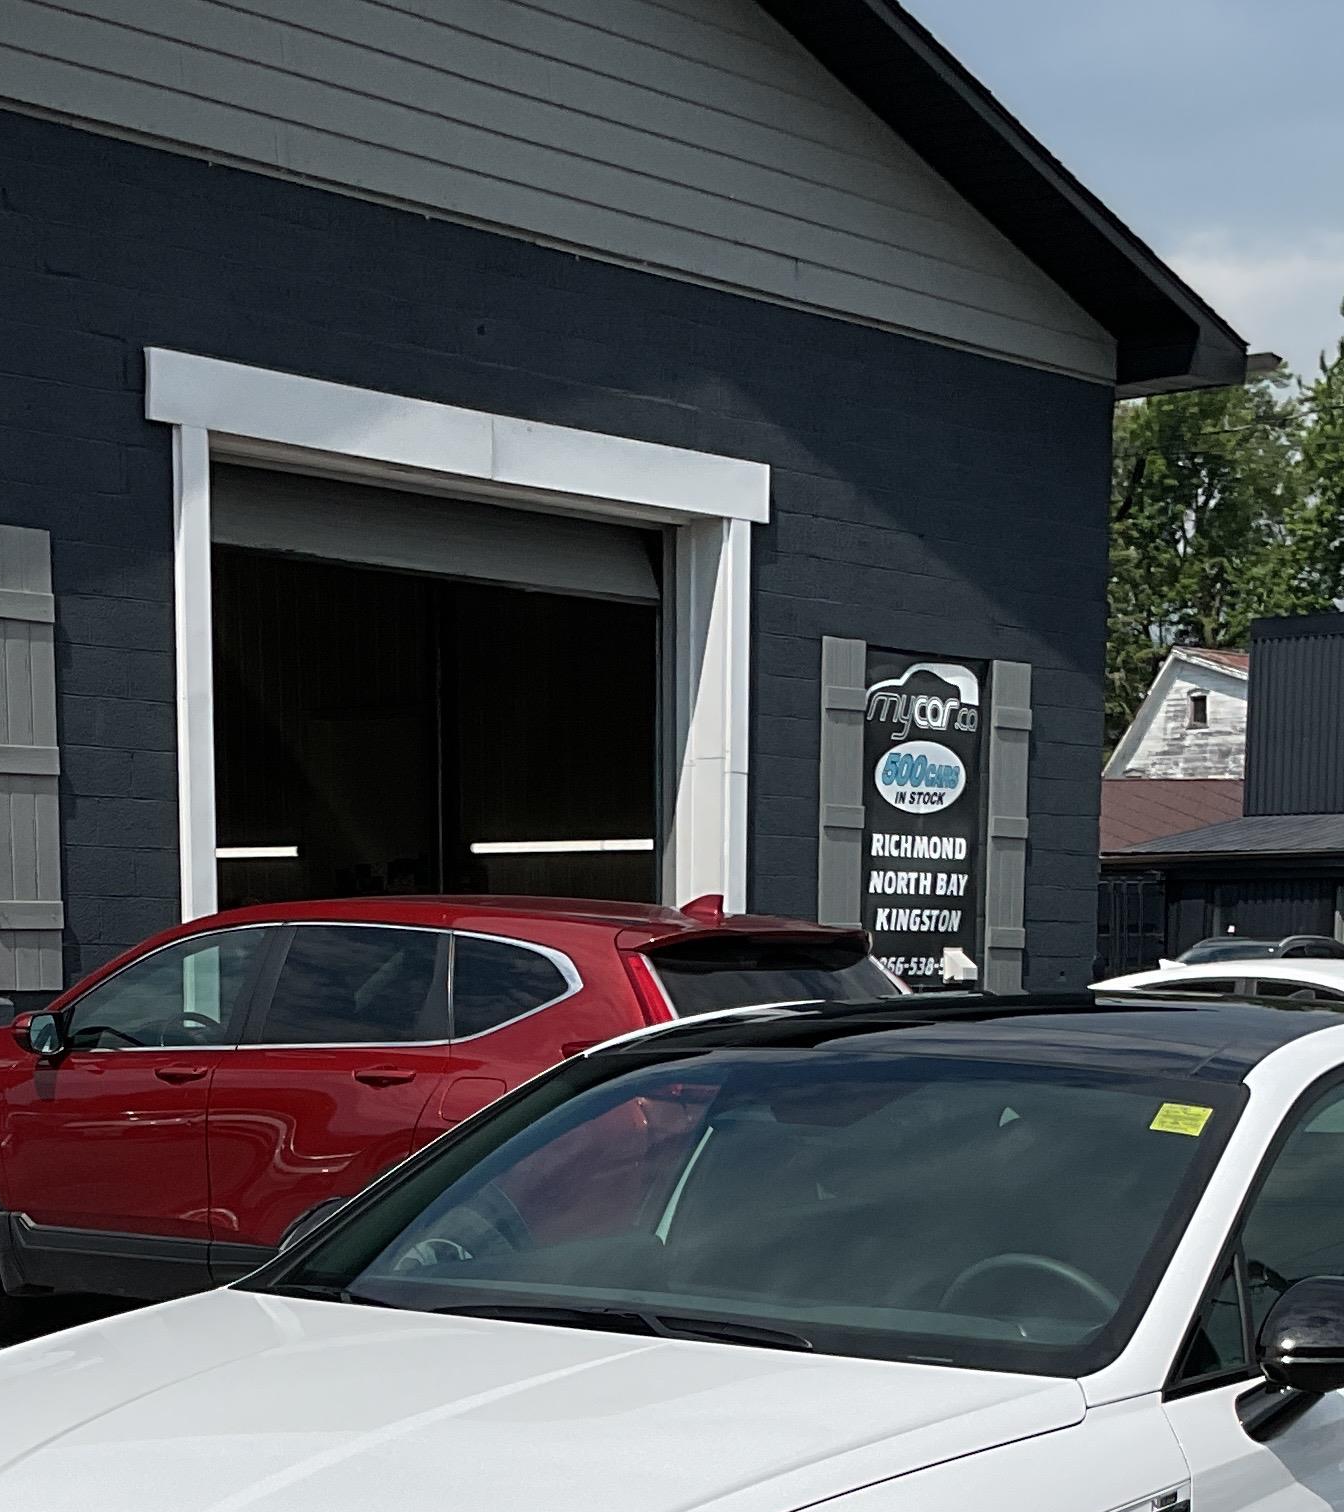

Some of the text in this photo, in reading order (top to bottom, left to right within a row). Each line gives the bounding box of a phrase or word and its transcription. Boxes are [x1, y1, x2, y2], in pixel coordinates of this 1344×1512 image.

[867, 691, 978, 740] mycar.ca
[894, 791, 946, 806] IN STOCK
[871, 832, 967, 861] RICHMOND
[869, 871, 969, 897] NORTH BAY
[875, 907, 962, 933] KINGSTON
